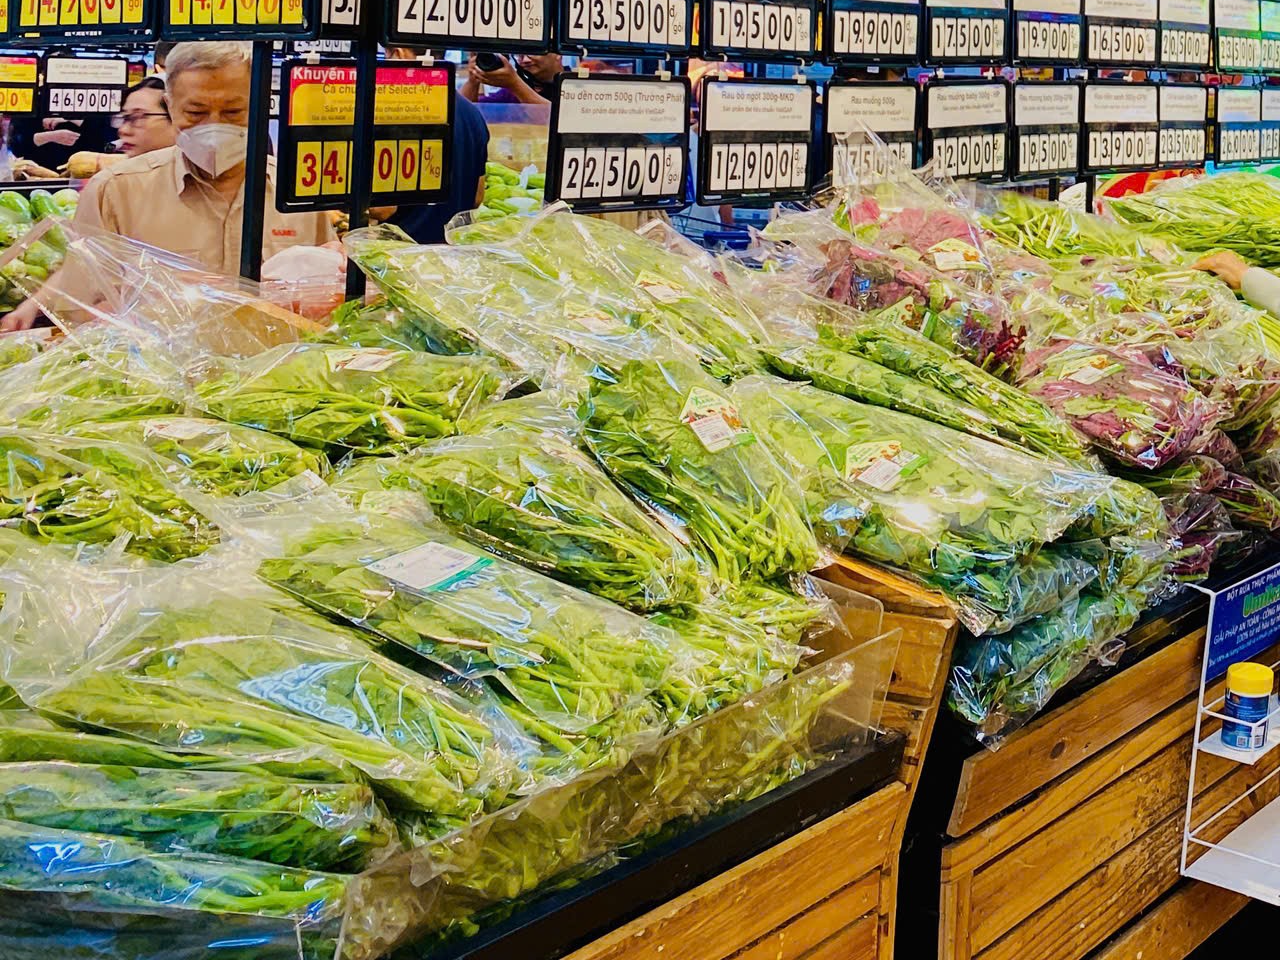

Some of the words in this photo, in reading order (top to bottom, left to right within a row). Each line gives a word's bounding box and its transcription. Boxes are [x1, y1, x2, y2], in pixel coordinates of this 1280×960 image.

[718, 7, 793, 42] 19.500
[839, 17, 903, 44] 19.900
[936, 24, 991, 48] 17.500
[1021, 27, 1068, 49] 19.900
[1092, 30, 1145, 54] 16.500
[1163, 34, 1200, 61] 20.500
[52, 93, 108, 107] 46.900
[1022, 141, 1068, 165] 19.500
[1093, 138, 1145, 159] 13.900
[1161, 133, 1197, 156] 23.500
[302, 147, 415, 188] 34.00
[566, 153, 659, 190] 22.500
